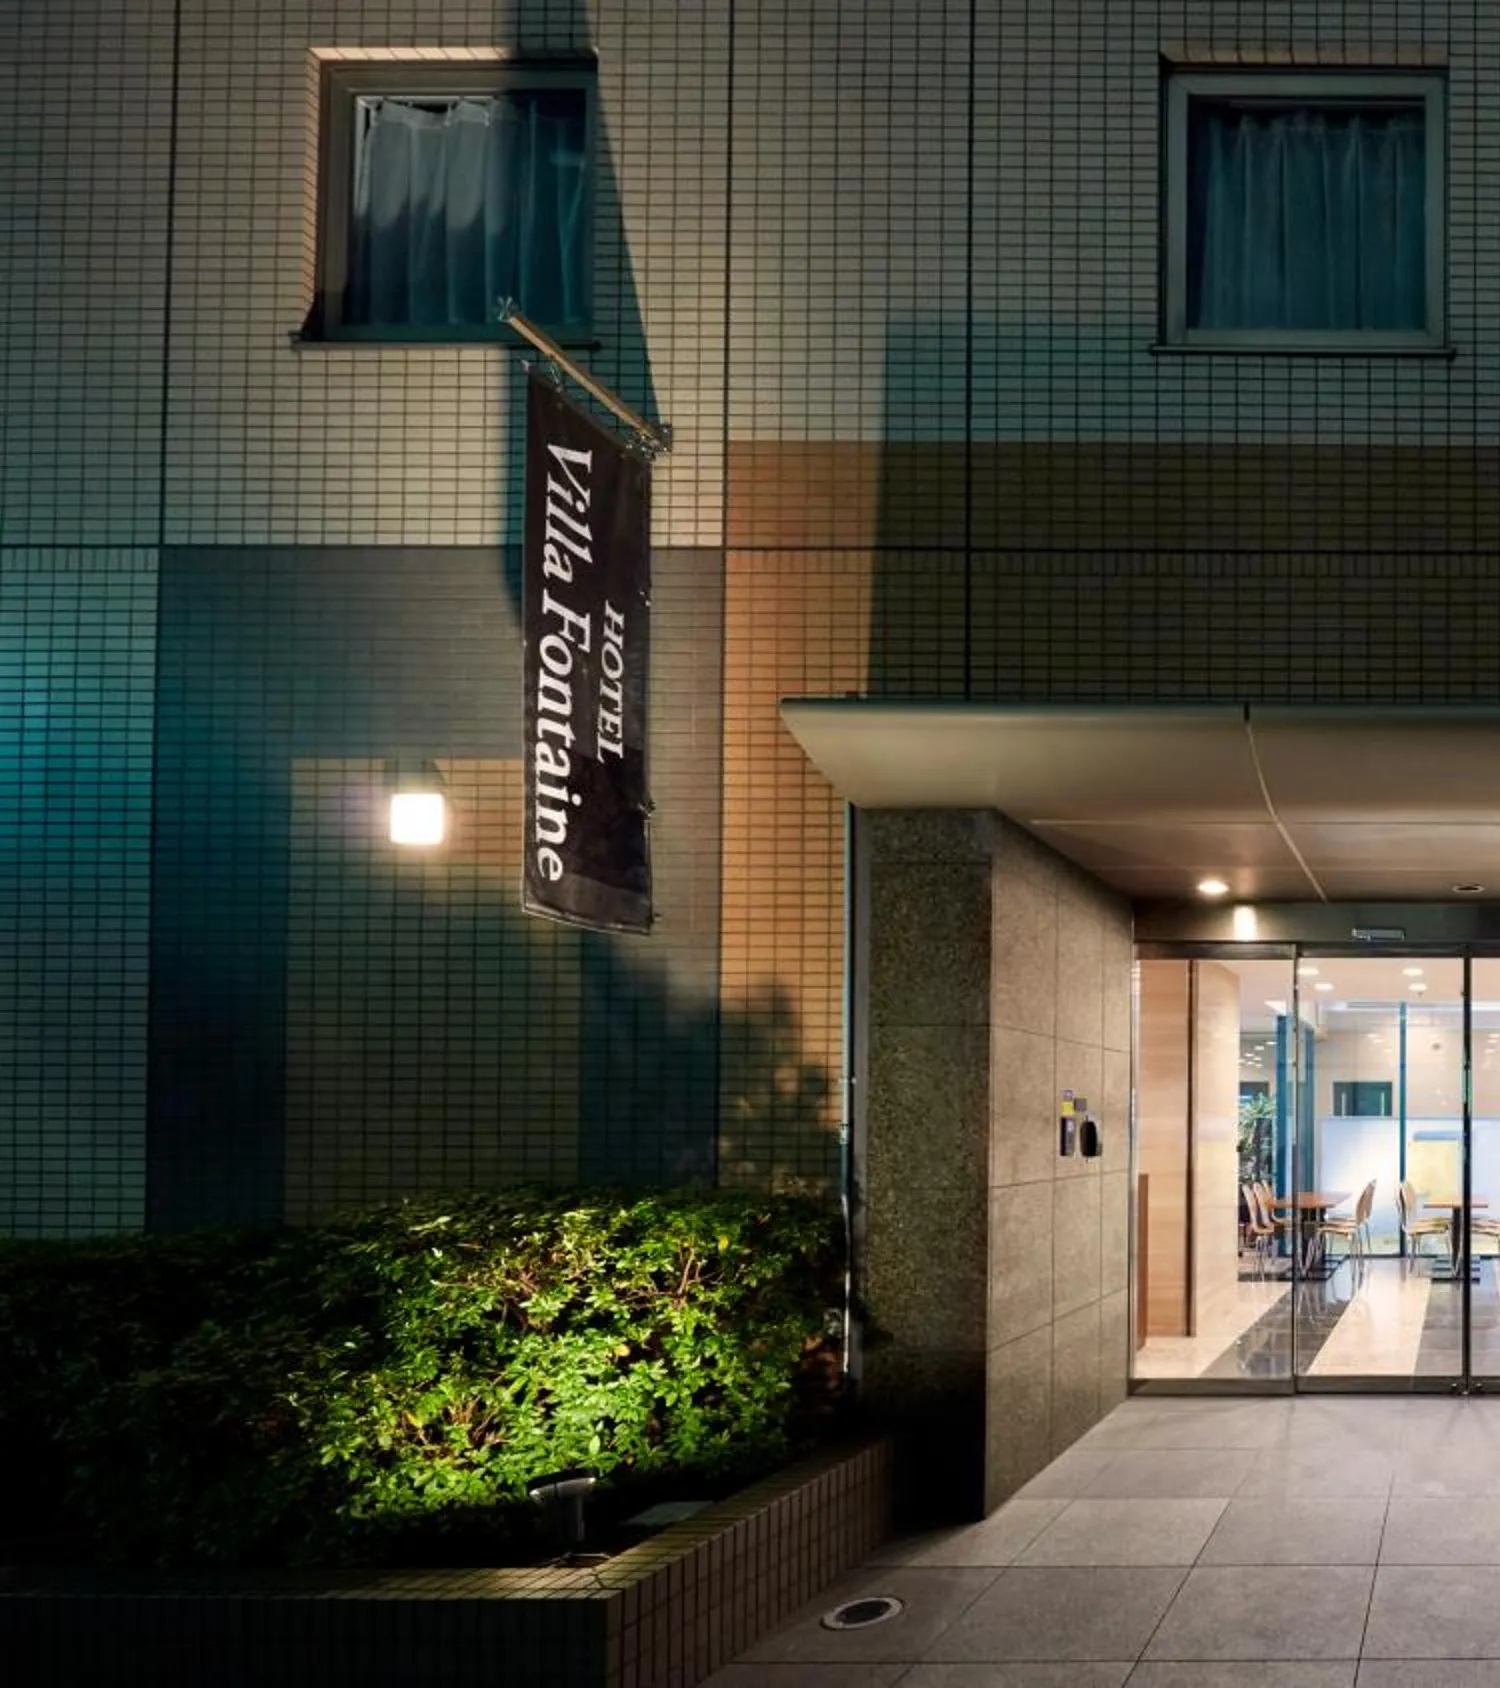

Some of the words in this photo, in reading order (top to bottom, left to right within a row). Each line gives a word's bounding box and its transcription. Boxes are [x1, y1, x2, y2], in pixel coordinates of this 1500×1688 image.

[543, 442, 593, 583] Villa
[534, 588, 592, 882] Fontaine
[597, 600, 625, 762] HOTEL
